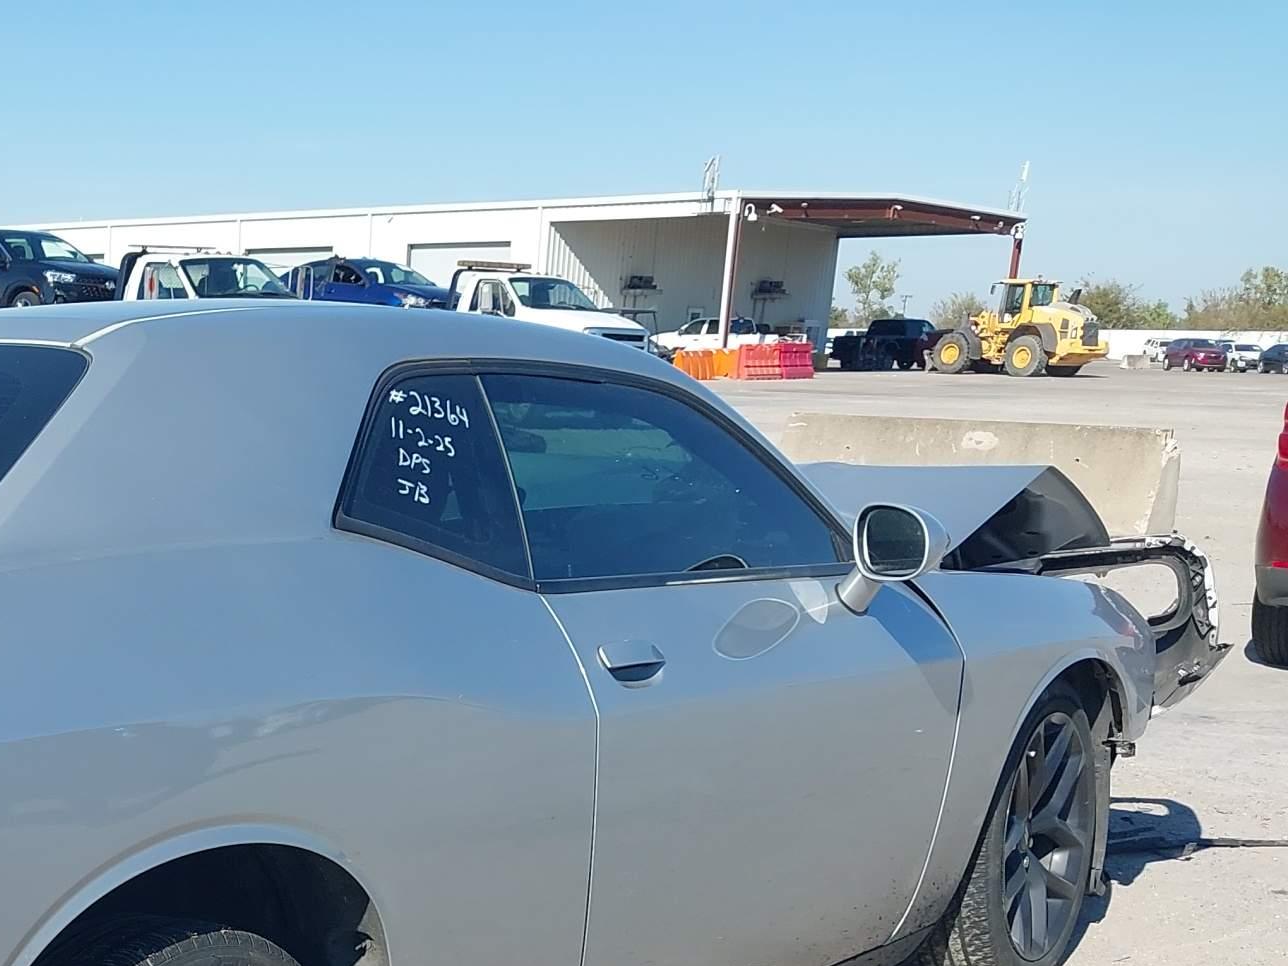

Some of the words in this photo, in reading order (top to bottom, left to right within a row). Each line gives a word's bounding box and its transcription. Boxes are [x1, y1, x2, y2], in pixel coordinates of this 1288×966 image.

[389, 389, 469, 428] #21364
[391, 417, 455, 456] 11-2-25
[398, 447, 431, 474] DPS
[397, 478, 430, 503] JB
